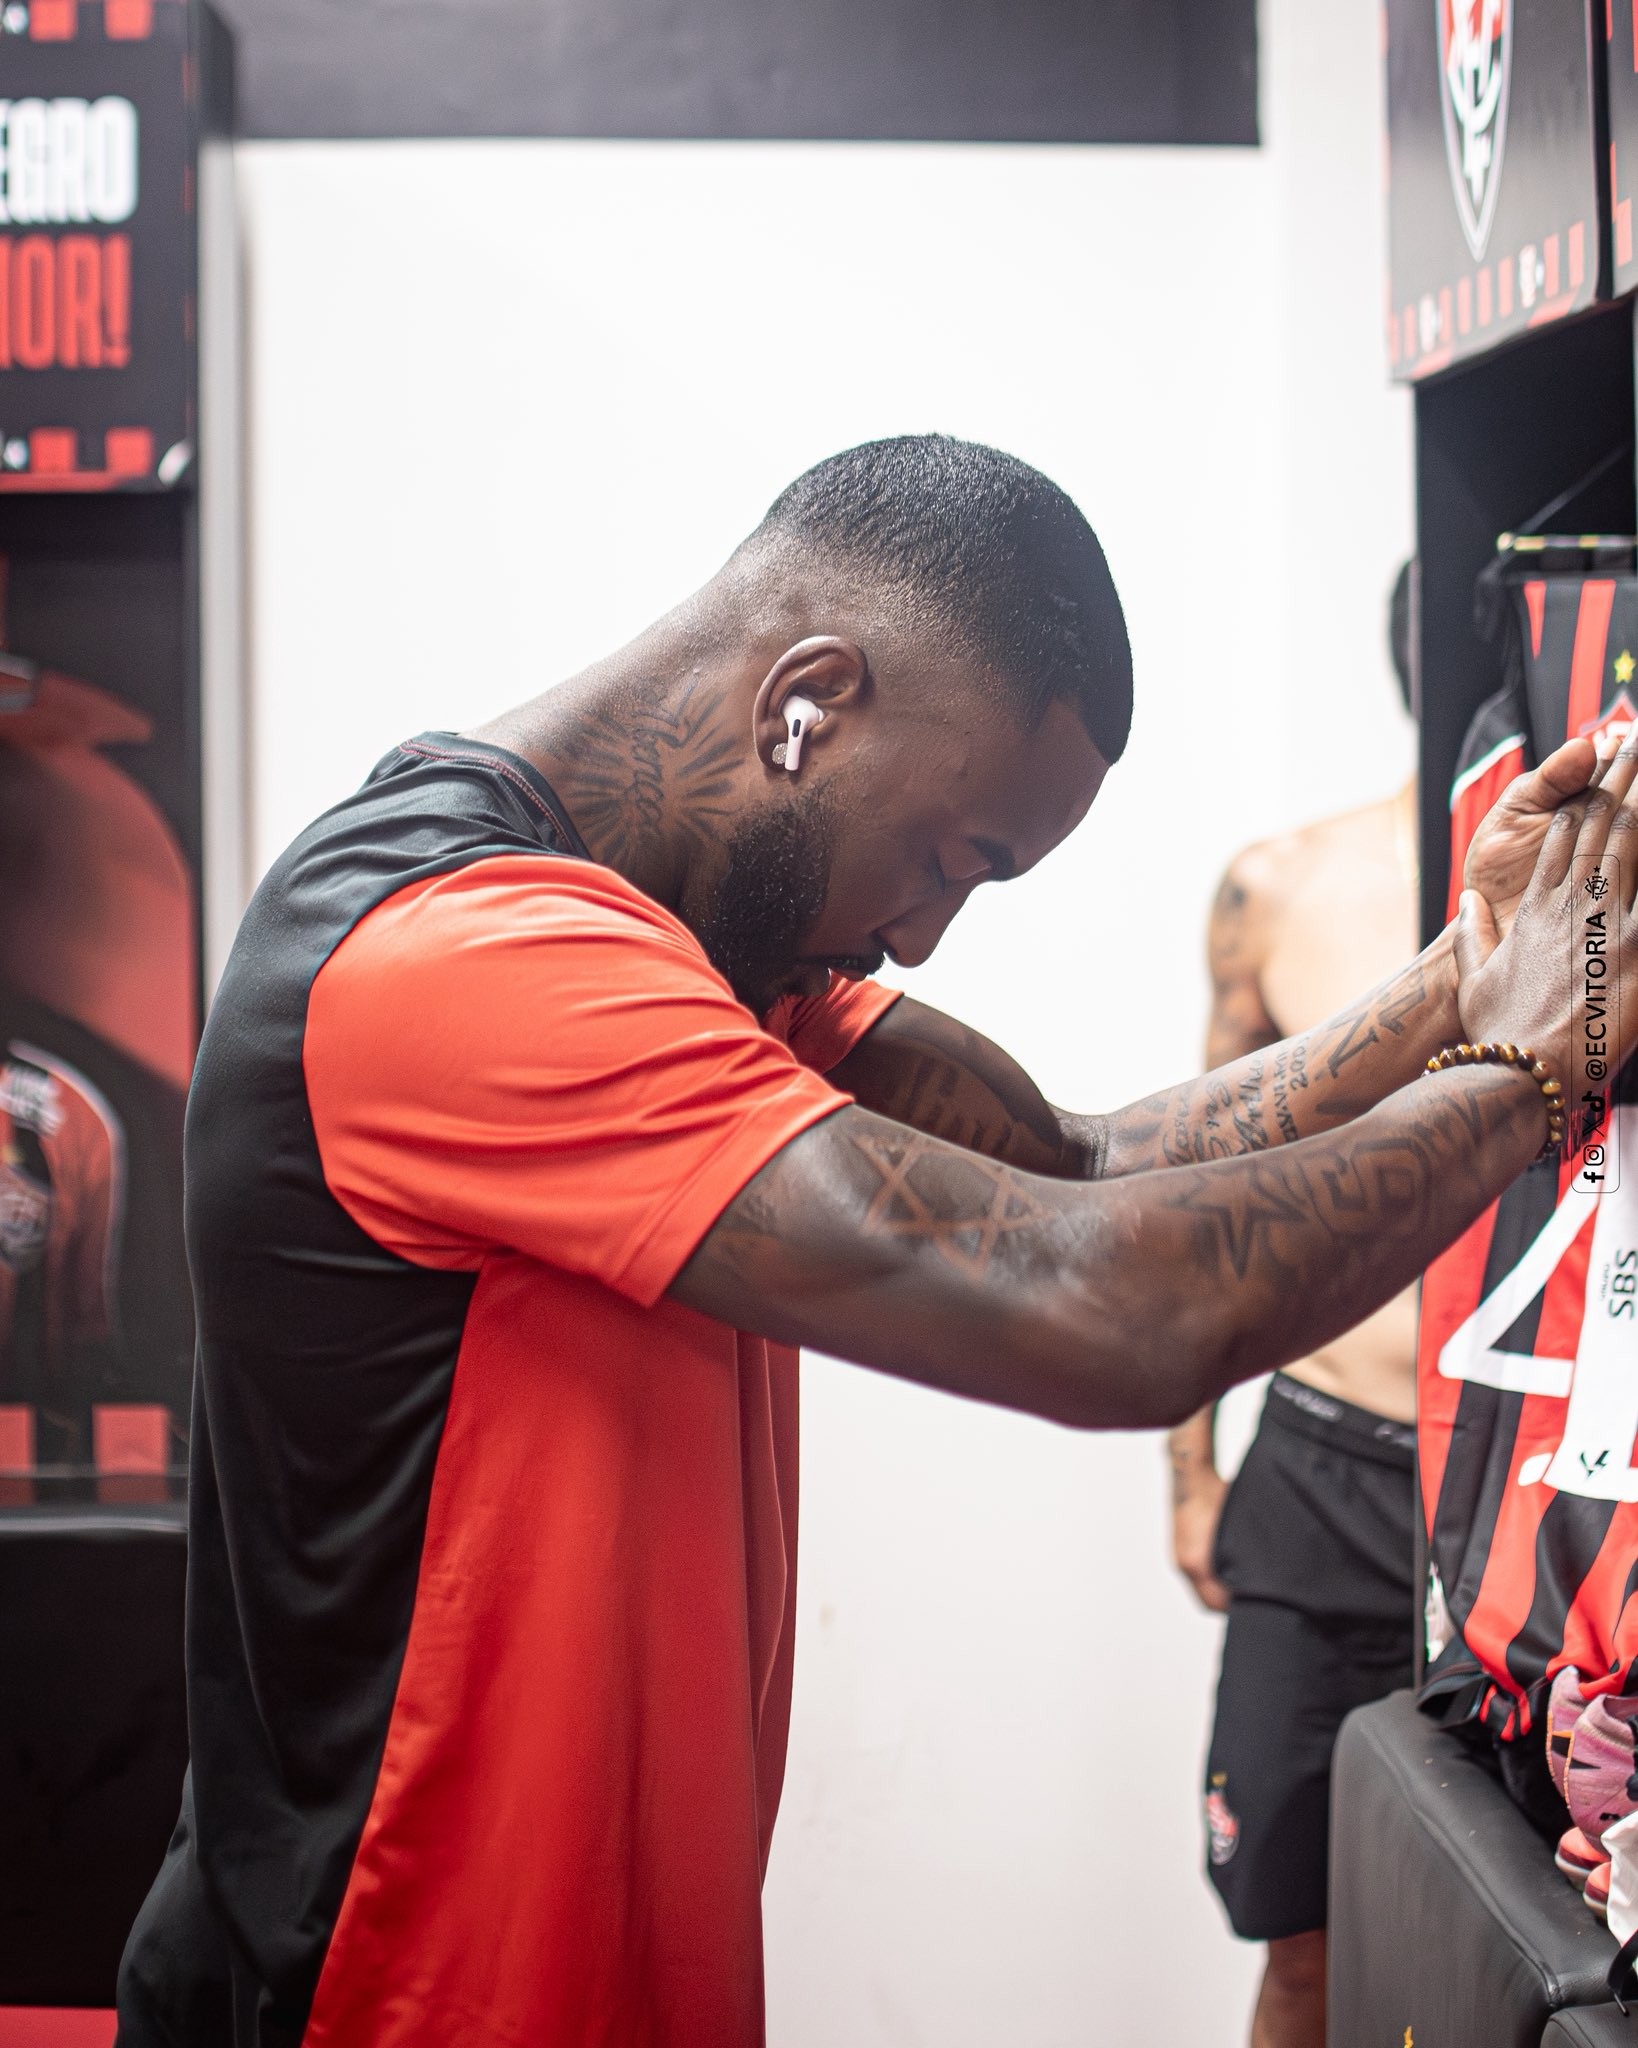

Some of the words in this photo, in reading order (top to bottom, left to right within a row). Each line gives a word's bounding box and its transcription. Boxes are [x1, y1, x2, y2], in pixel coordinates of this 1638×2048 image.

[0, 96, 139, 224] GRO
[0, 232, 131, 370] OR!
[1608, 1249, 1638, 1319] SBS
